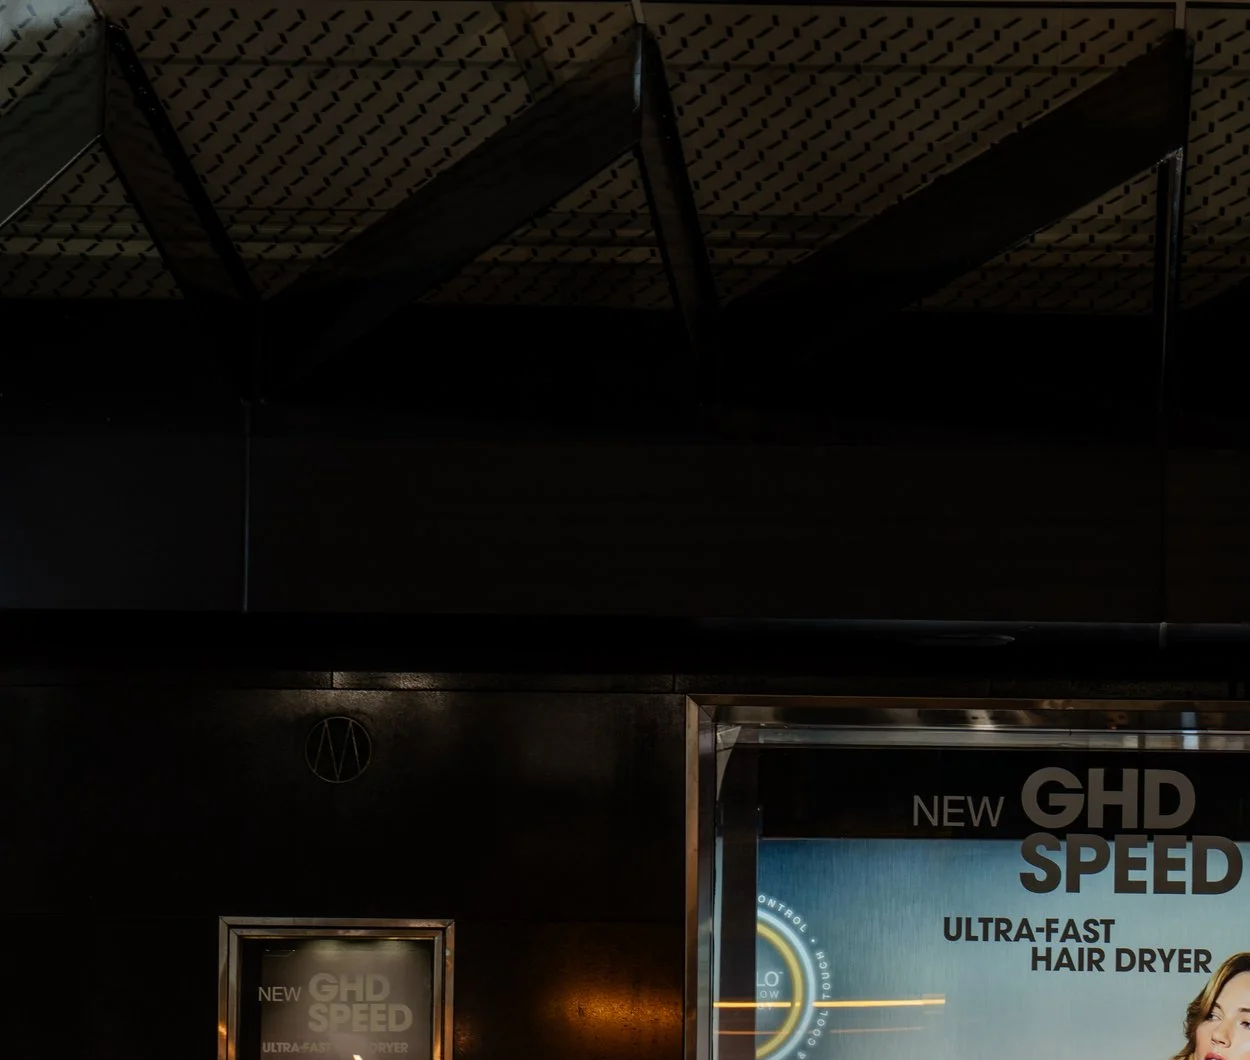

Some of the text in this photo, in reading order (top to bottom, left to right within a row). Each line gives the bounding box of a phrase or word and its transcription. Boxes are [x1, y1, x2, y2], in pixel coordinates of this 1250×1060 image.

[912, 766, 1197, 830] NEW GHD
[1019, 831, 1243, 895] SPEED
[757, 894, 808, 933] ONTROL
[943, 917, 1116, 944] ULTRA-FAST
[815, 951, 831, 1000] TOUCH
[1030, 946, 1212, 974] HAIR DRYER
[257, 972, 391, 1002] NEW GHD
[308, 1003, 413, 1033] SPEED
[807, 1009, 829, 1047] COOL
[262, 1042, 332, 1053] ULTRA-FAST
[371, 1042, 409, 1053] DRYER
